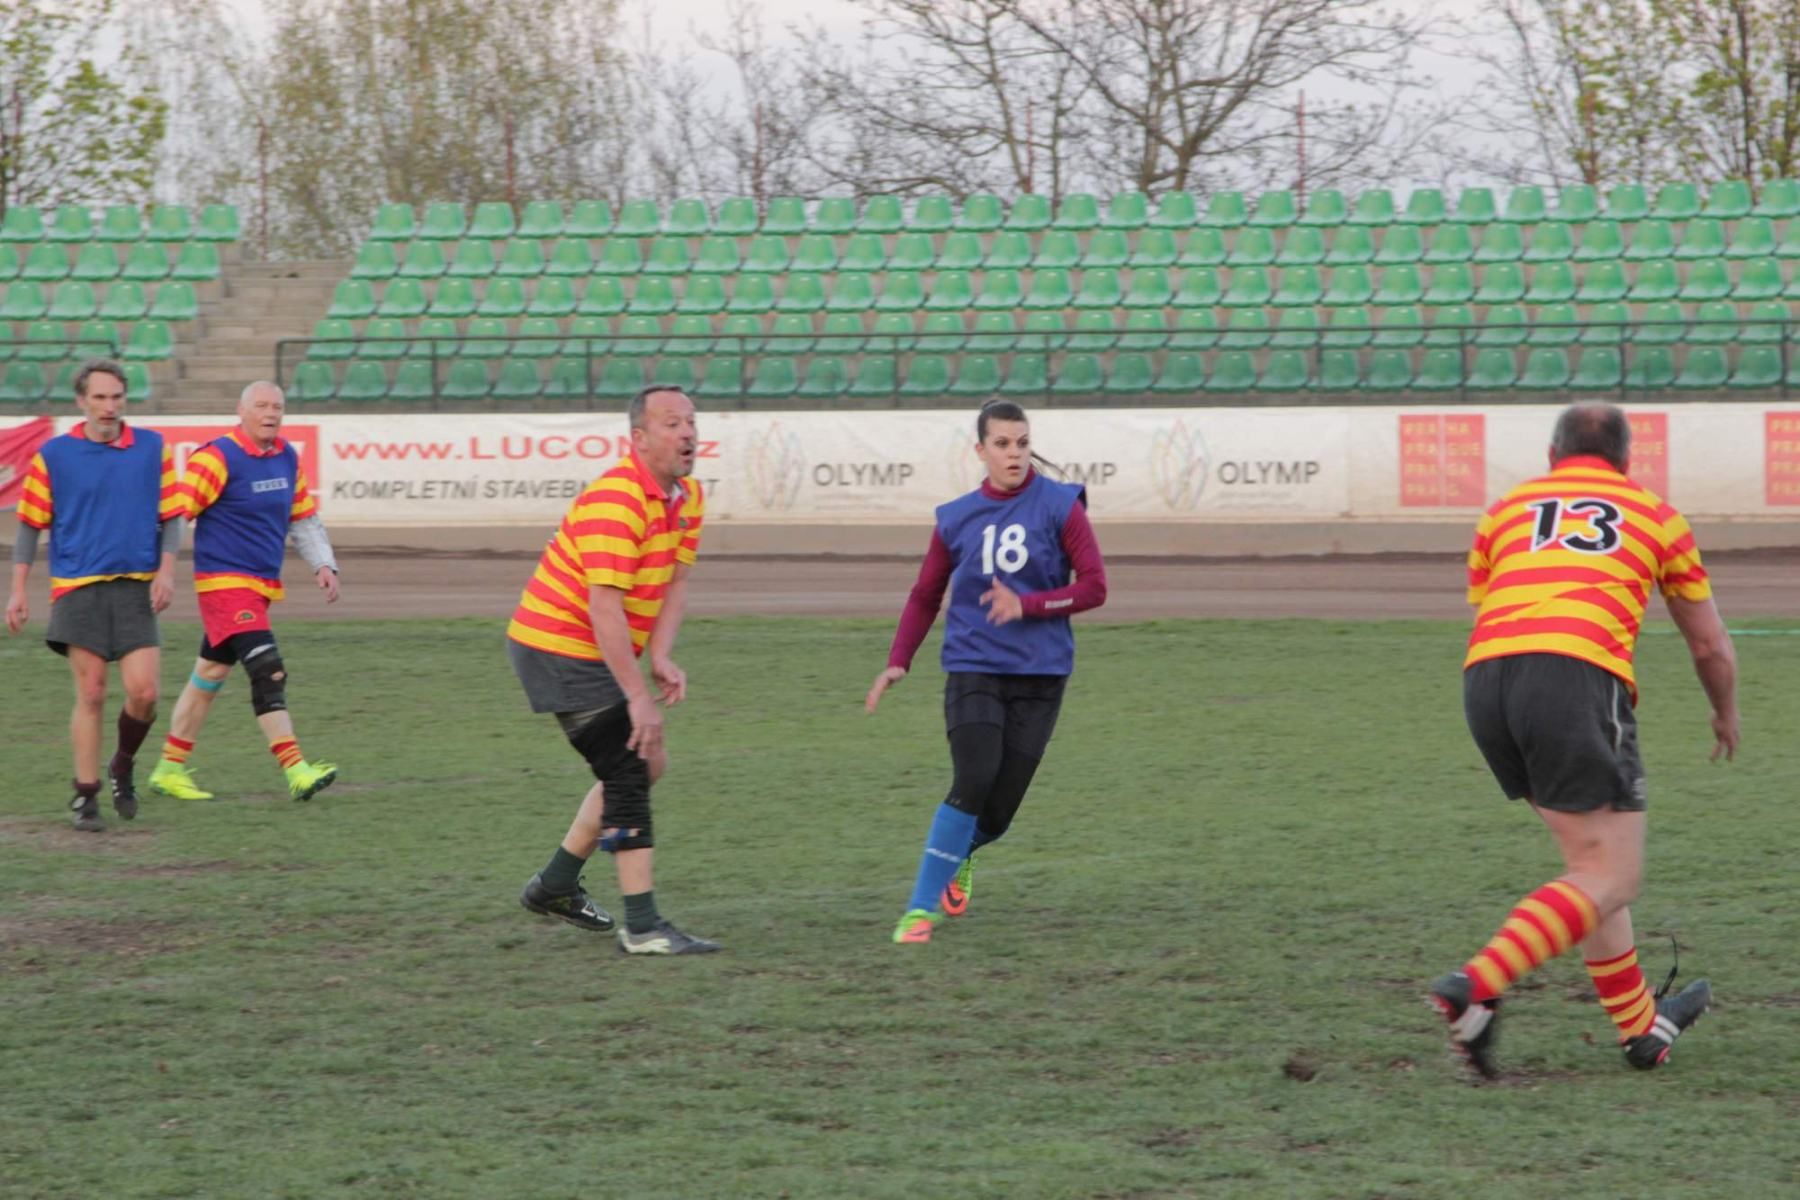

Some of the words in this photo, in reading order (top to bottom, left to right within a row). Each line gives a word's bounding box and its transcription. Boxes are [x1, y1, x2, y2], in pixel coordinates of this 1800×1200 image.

[812, 462, 914, 487] OLYMP
[1217, 460, 1321, 485] OLYMP
[332, 474, 479, 499] KOMPLETNÍ
[1525, 497, 1625, 556] 13
[981, 523, 1029, 575] 18
